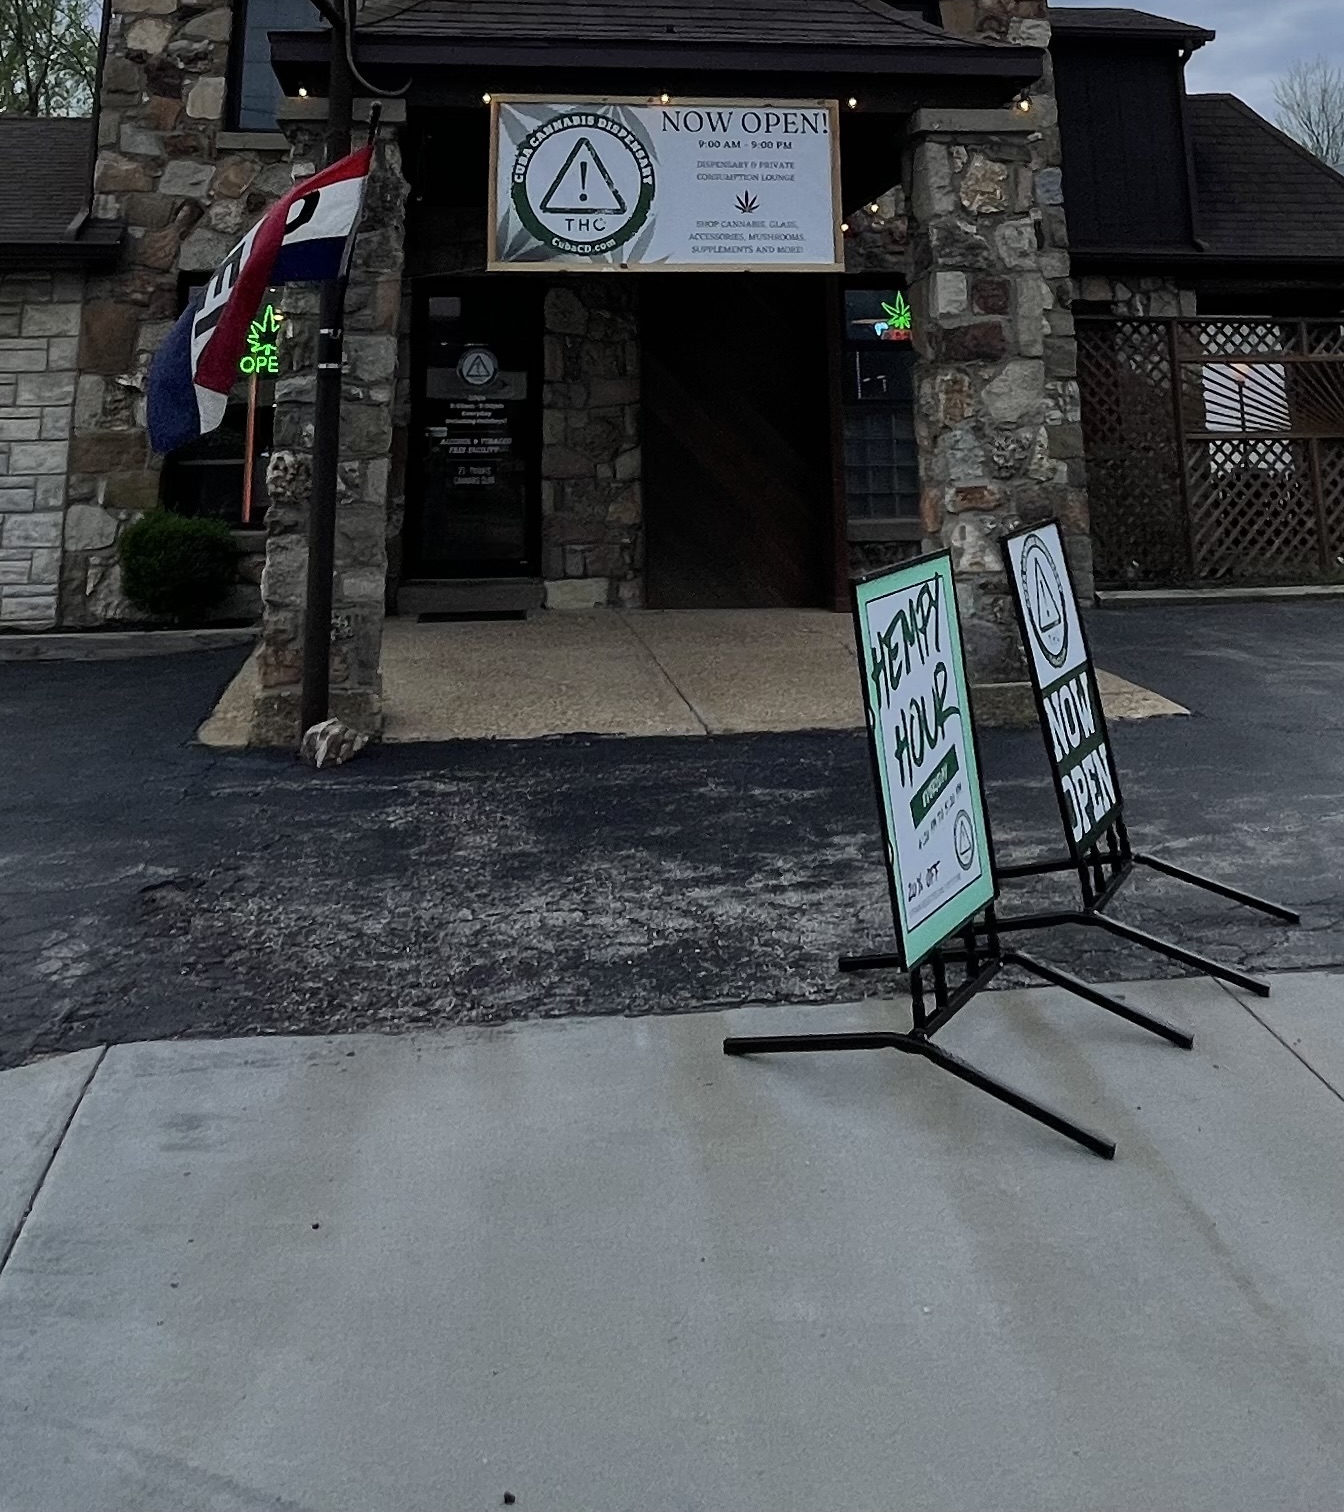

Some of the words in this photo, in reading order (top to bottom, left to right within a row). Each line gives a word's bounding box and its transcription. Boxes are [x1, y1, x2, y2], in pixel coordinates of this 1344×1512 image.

[661, 110, 733, 133] NOW
[741, 111, 829, 135] OPEN!
[514, 148, 534, 183] CUBA
[529, 115, 595, 147] CANNABIS
[597, 116, 653, 185] DISPENSARY
[698, 140, 721, 149] 9:00
[723, 140, 741, 149] AM
[751, 141, 773, 149] 9:00
[776, 141, 792, 149] PM
[759, 161, 795, 169] PRIVATE
[761, 173, 795, 182] LOUNGE
[565, 218, 607, 232] THC
[696, 220, 719, 228] SHOP
[551, 237, 616, 254] CubaCD.com
[691, 245, 753, 254] SUPPLEMENTS
[755, 245, 775, 254] AND
[240, 356, 279, 374] OPE
[871, 572, 943, 709] HEMPY
[895, 662, 960, 787] HOUR
[1043, 672, 1096, 762] NOW
[1061, 743, 1116, 843] OPEN
